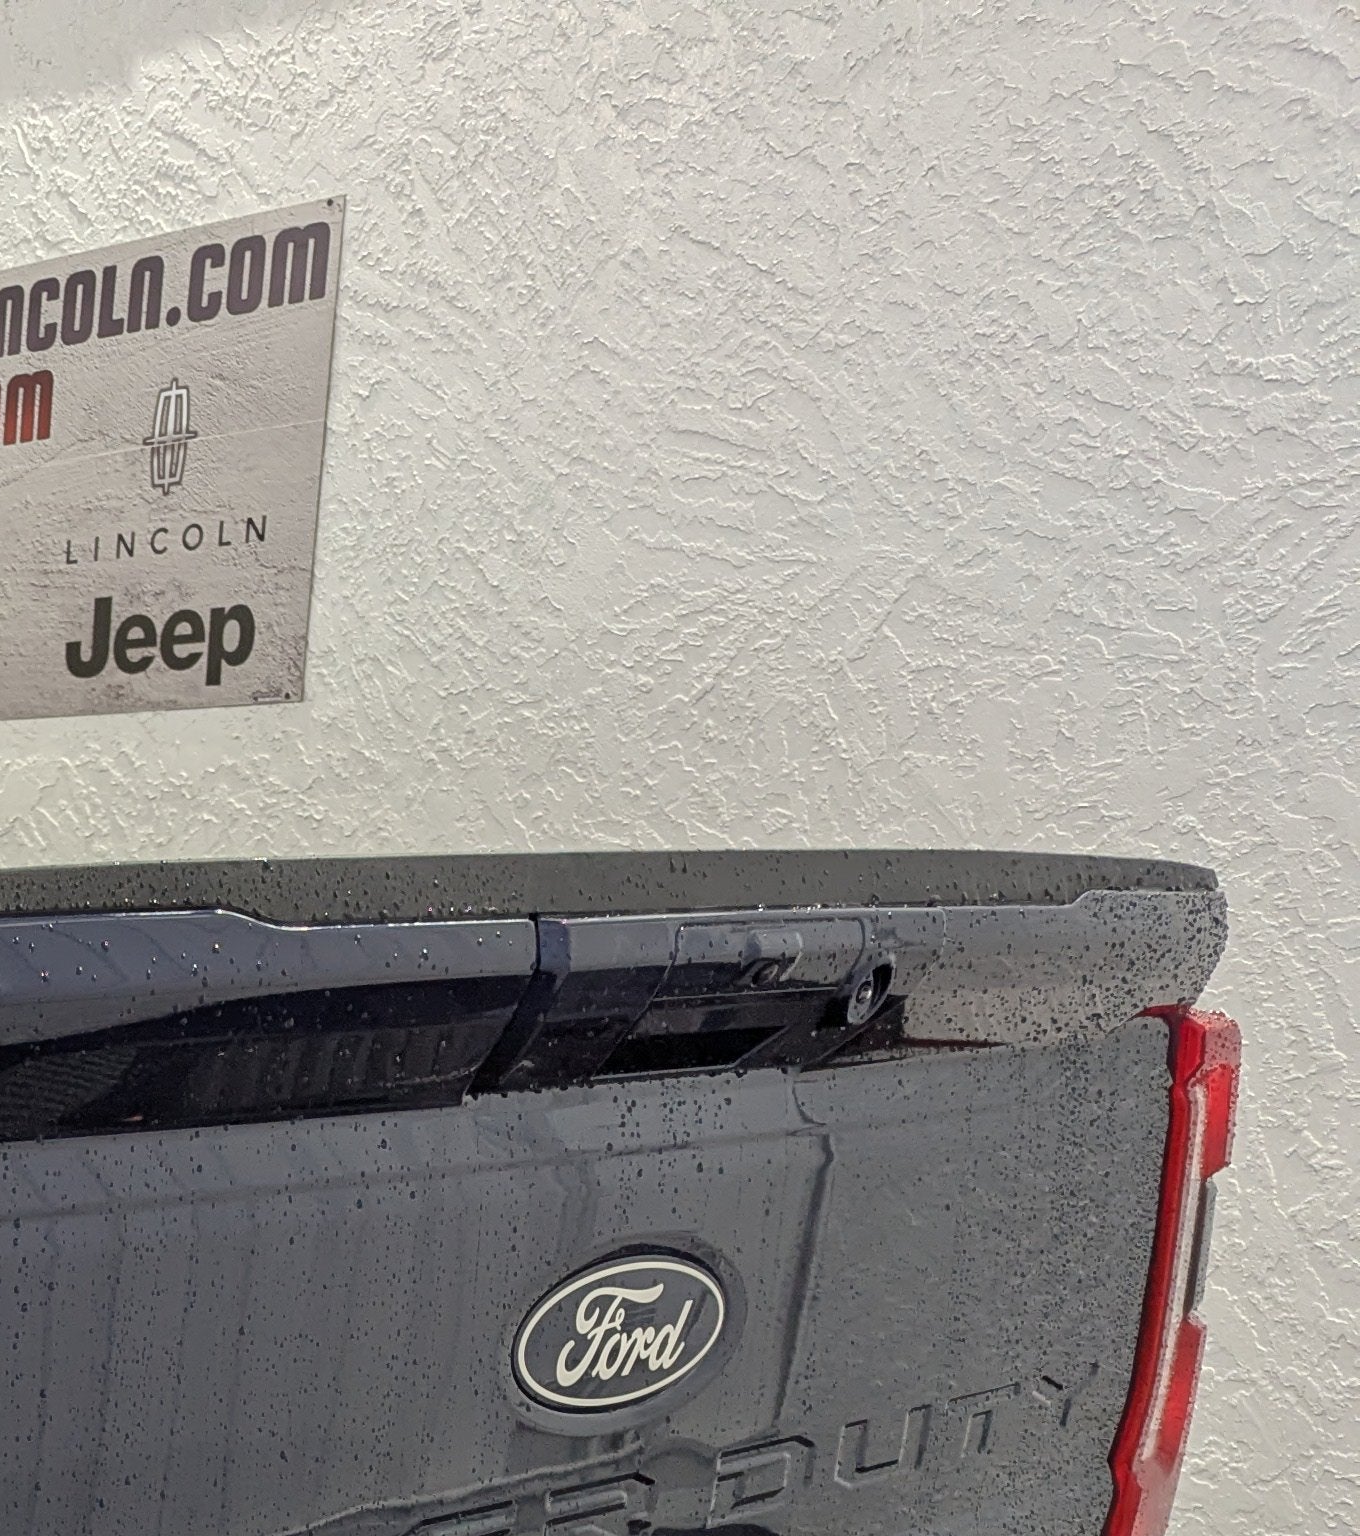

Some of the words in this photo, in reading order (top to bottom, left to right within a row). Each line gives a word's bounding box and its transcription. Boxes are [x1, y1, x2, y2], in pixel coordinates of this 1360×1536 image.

[66, 515, 267, 565] LINCOLN
[65, 596, 256, 686] Jeep
[556, 1283, 694, 1387] Ford
[705, 1360, 1100, 1530] DUTY
